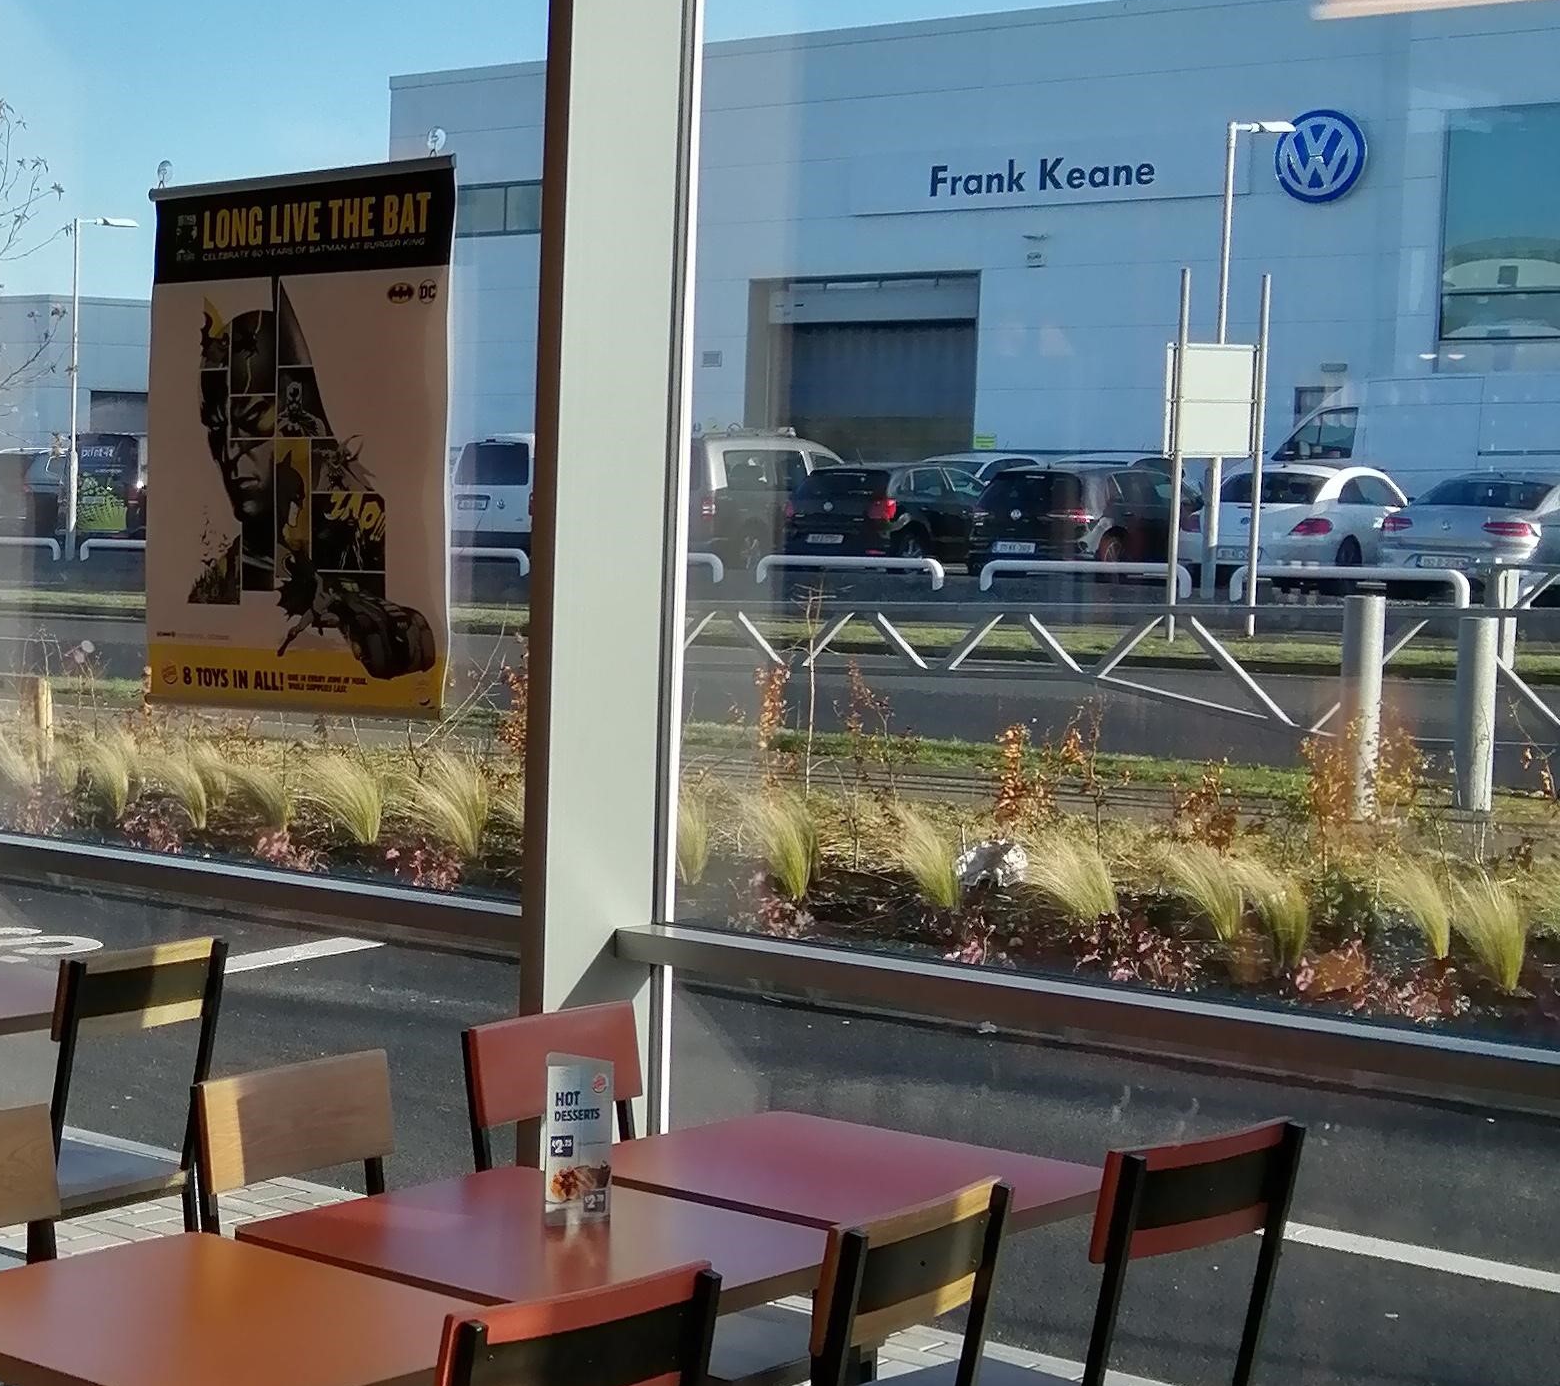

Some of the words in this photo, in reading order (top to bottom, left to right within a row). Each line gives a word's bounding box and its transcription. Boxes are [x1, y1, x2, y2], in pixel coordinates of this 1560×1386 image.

[929, 158, 1025, 197] Frank
[1039, 156, 1156, 191] Keane
[202, 205, 263, 250] LONG
[269, 200, 322, 244] LIVE
[328, 196, 376, 240] THE
[382, 191, 432, 236] BAT
[265, 246, 294, 257] YEARS
[295, 245, 306, 254] OF
[308, 243, 347, 254] BATMAN
[349, 242, 361, 251] AT
[363, 238, 401, 250] BURGER
[402, 237, 426, 247] KING
[419, 284, 436, 300] DC
[183, 666, 192, 685] 8
[196, 667, 229, 688] TOYS
[233, 669, 248, 689] IN
[254, 670, 284, 691] ALL!
[555, 1091, 581, 1107] HOT
[554, 1108, 600, 1123] DESSERTS
